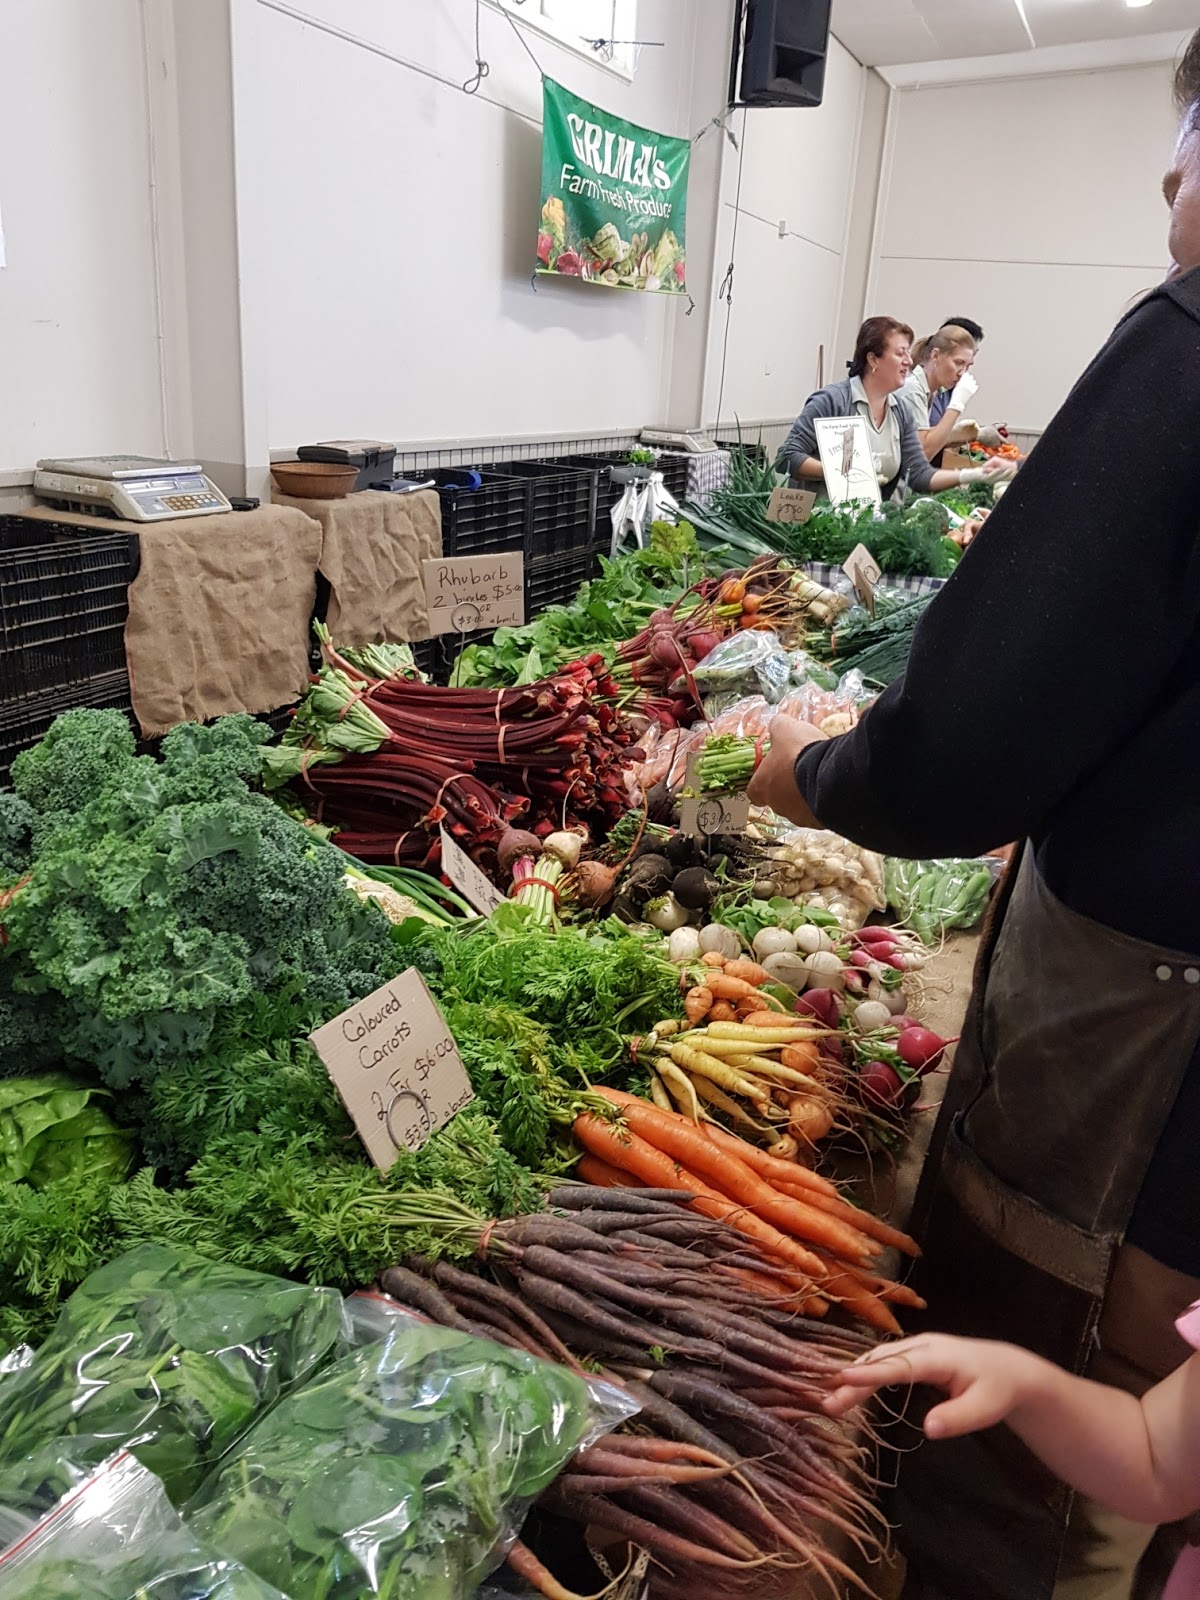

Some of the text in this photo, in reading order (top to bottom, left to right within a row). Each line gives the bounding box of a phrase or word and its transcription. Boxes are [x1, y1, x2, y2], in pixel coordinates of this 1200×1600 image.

[567, 113, 671, 190] GRIMA's
[560, 163, 672, 219] Farm Fresh Produce
[437, 565, 508, 588] Rhubarb
[433, 596, 447, 608] 2
[492, 585, 523, 602] $5.00
[480, 604, 491, 612] OR
[458, 615, 485, 628] $3.00
[342, 990, 402, 1042] Coloured
[359, 1021, 411, 1069] Carrots
[371, 1038, 454, 1121] 2 For $6.00
[416, 1088, 431, 1109] OR
[405, 1111, 437, 1147] $3.50
